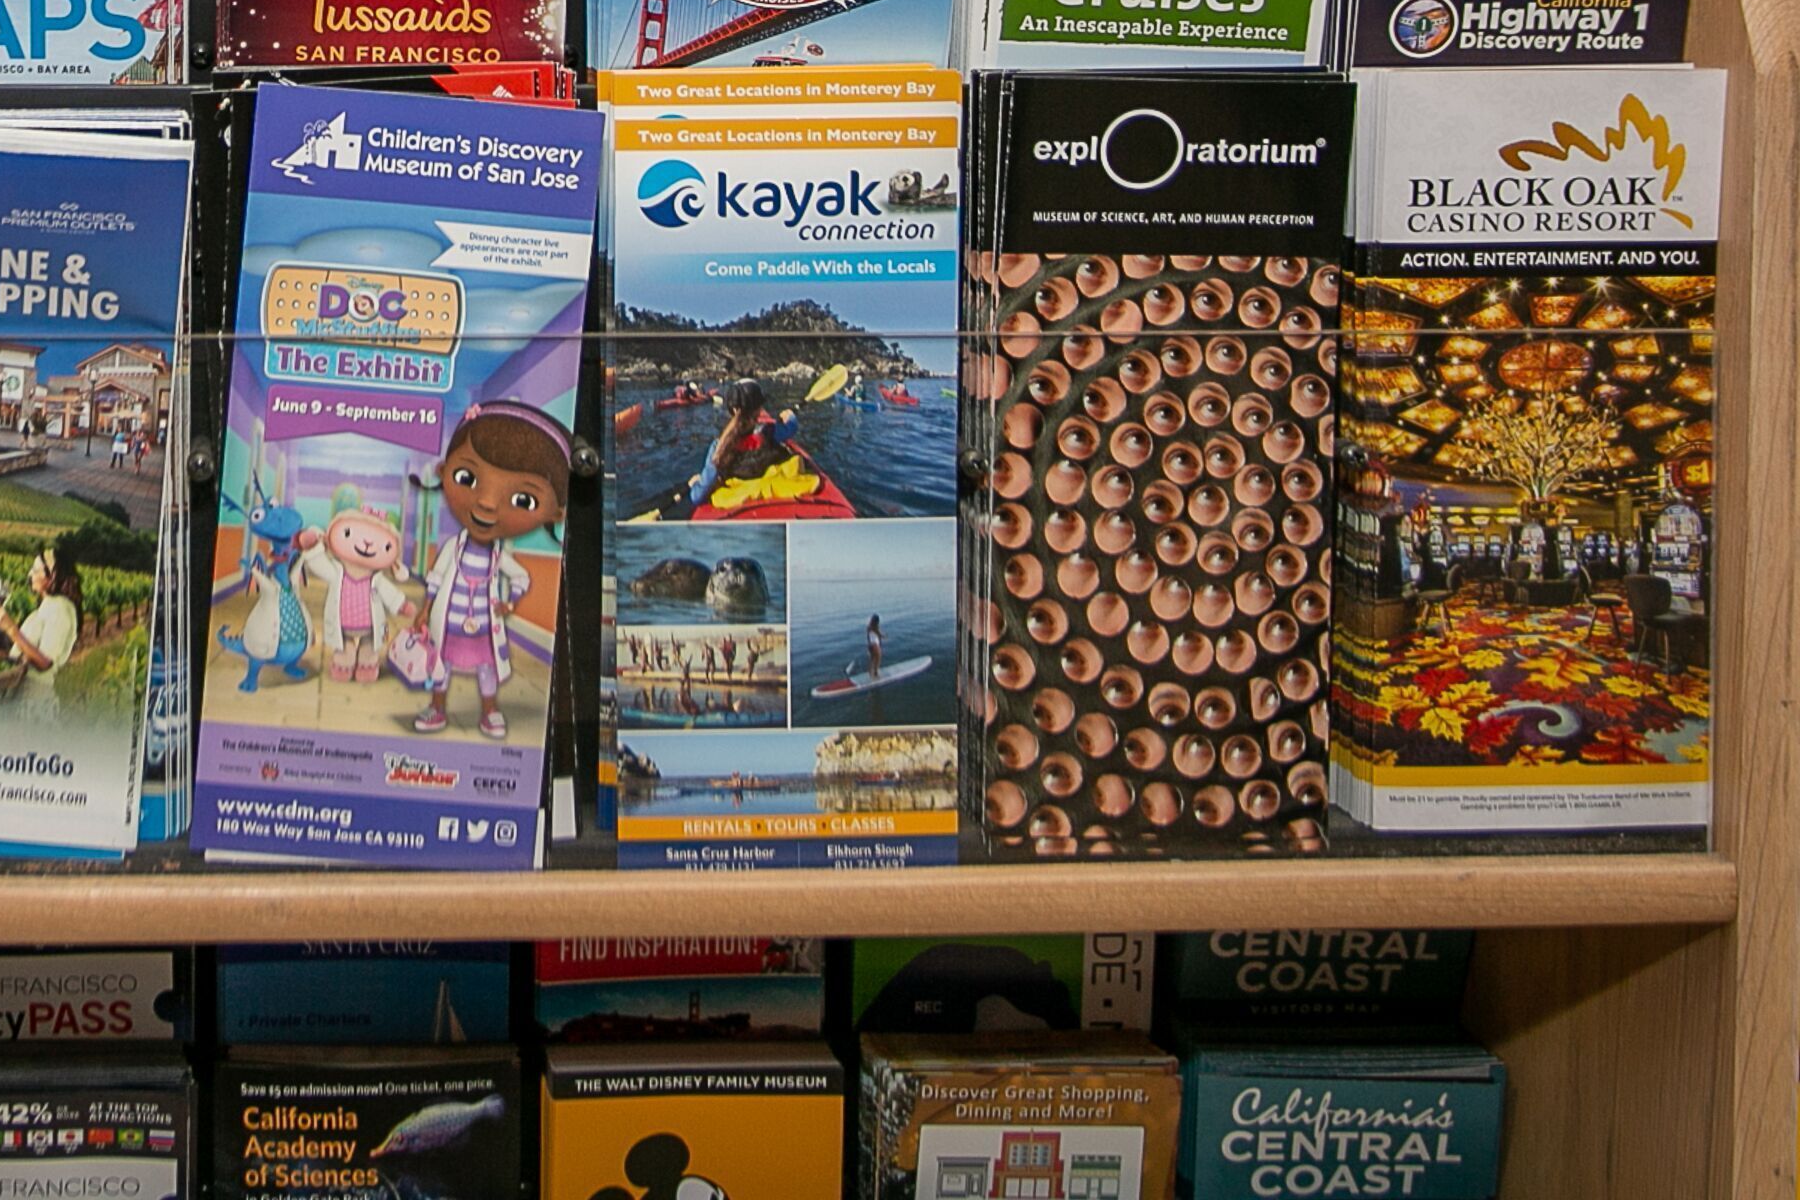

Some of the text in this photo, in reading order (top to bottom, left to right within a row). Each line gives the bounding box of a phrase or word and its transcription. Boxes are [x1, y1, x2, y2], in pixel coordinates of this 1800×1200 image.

[1019, 14, 1288, 41] An Inescapable Experience
[368, 128, 583, 168] Children's Discovery
[717, 170, 882, 227] kayak
[1408, 177, 1656, 207] BLACK OAK
[1033, 210, 1314, 225] MUSEUM OF SCIENCE, ART, AND HUMAN PERCEPTION
[1408, 212, 1656, 232] CASINO RESORT
[799, 219, 935, 240] connection
[62, 254, 90, 285] &
[706, 259, 936, 276] Come Paddle With the Locals
[1401, 250, 1699, 267] ACTION. ENTERTAINMENT. AND YOU.
[217, 798, 352, 824] www.cdm.org
[683, 817, 894, 834] RENTALS TOURS CLASSES
[0, 974, 137, 996] FRANCISCO
[576, 1076, 827, 1092] THE WALT DISNEY FAMILY MUSEUM
[921, 1085, 1150, 1103] Discover Great Shopping,
[243, 1107, 358, 1130] California
[1232, 1088, 1453, 1139] California's
[244, 1137, 356, 1162] Academy
[1221, 1131, 1462, 1162] CENTRAL
[245, 1165, 378, 1187] of Sciences
[1251, 1164, 1424, 1196] COAST
